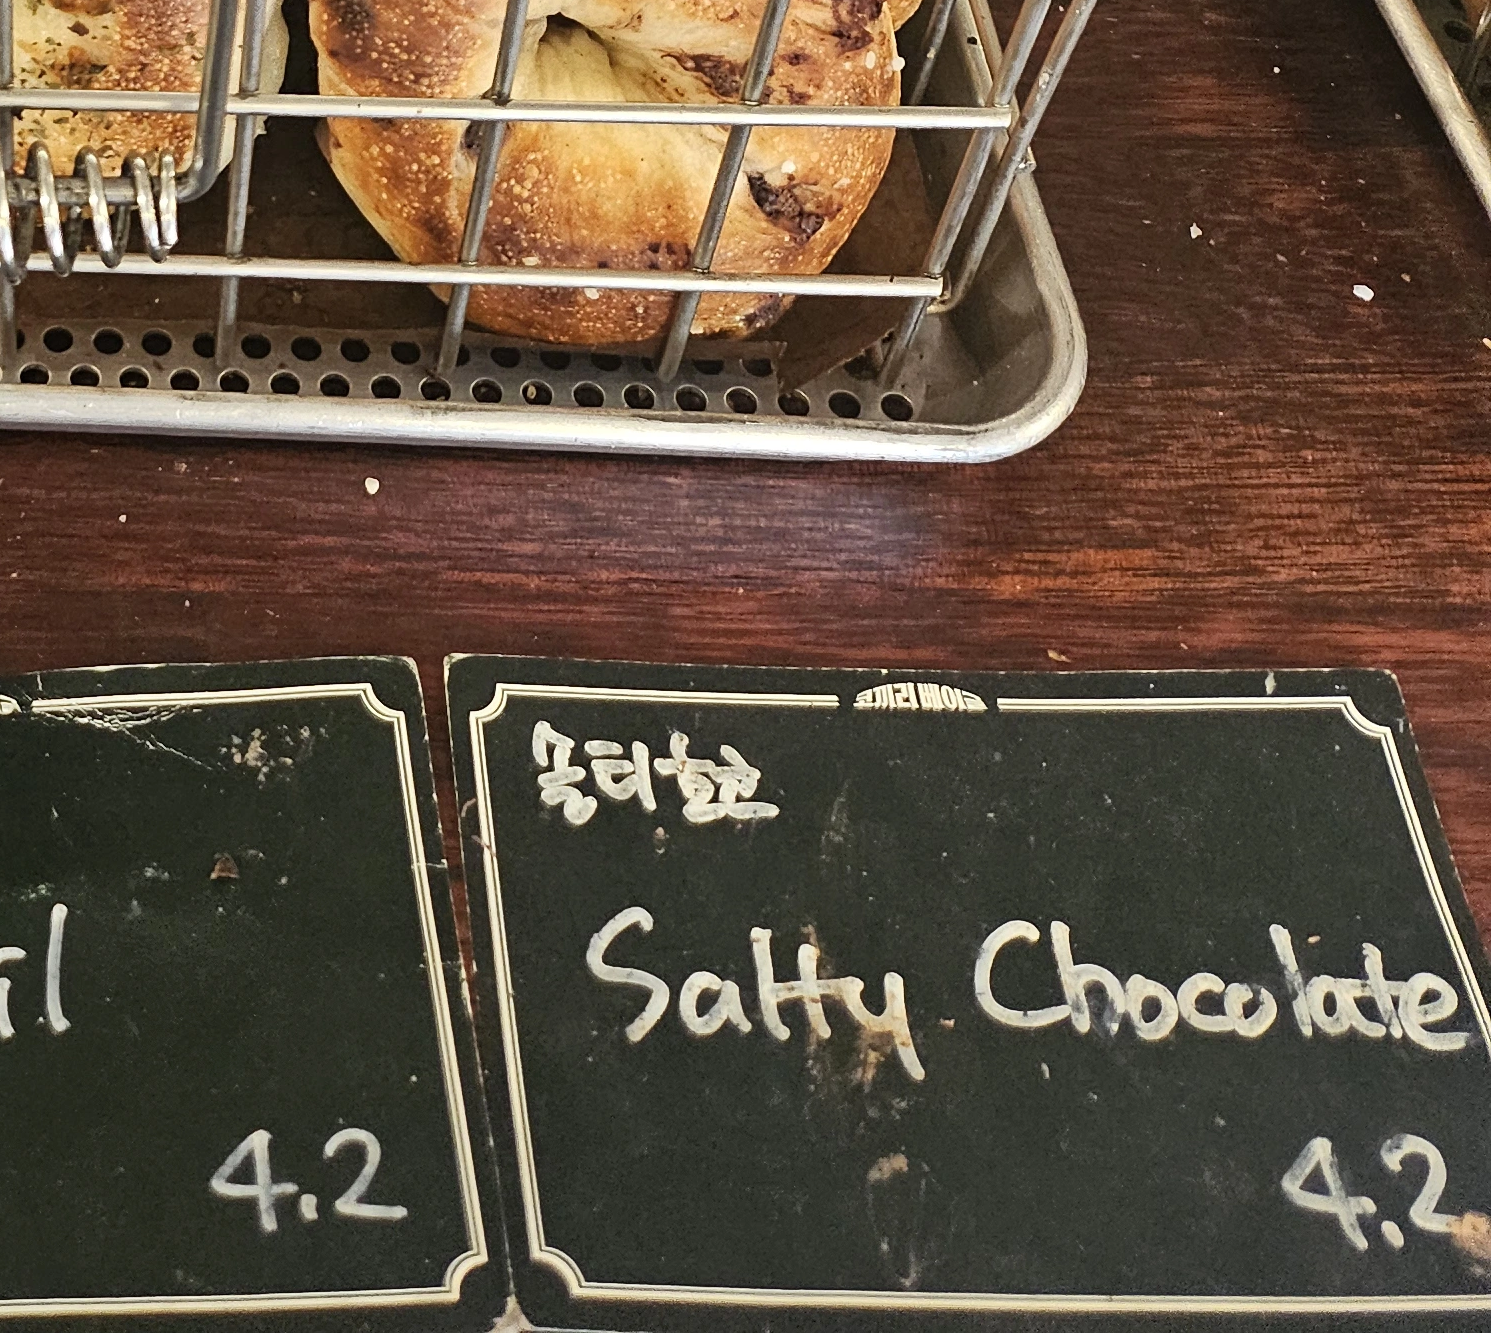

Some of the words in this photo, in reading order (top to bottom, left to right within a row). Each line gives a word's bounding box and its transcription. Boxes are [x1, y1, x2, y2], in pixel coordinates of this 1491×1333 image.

[586, 906, 926, 1082] Salty
[974, 918, 1473, 1053] Chocolate
[209, 1129, 409, 1233] 4.2
[1281, 1134, 1457, 1252] 4.2
